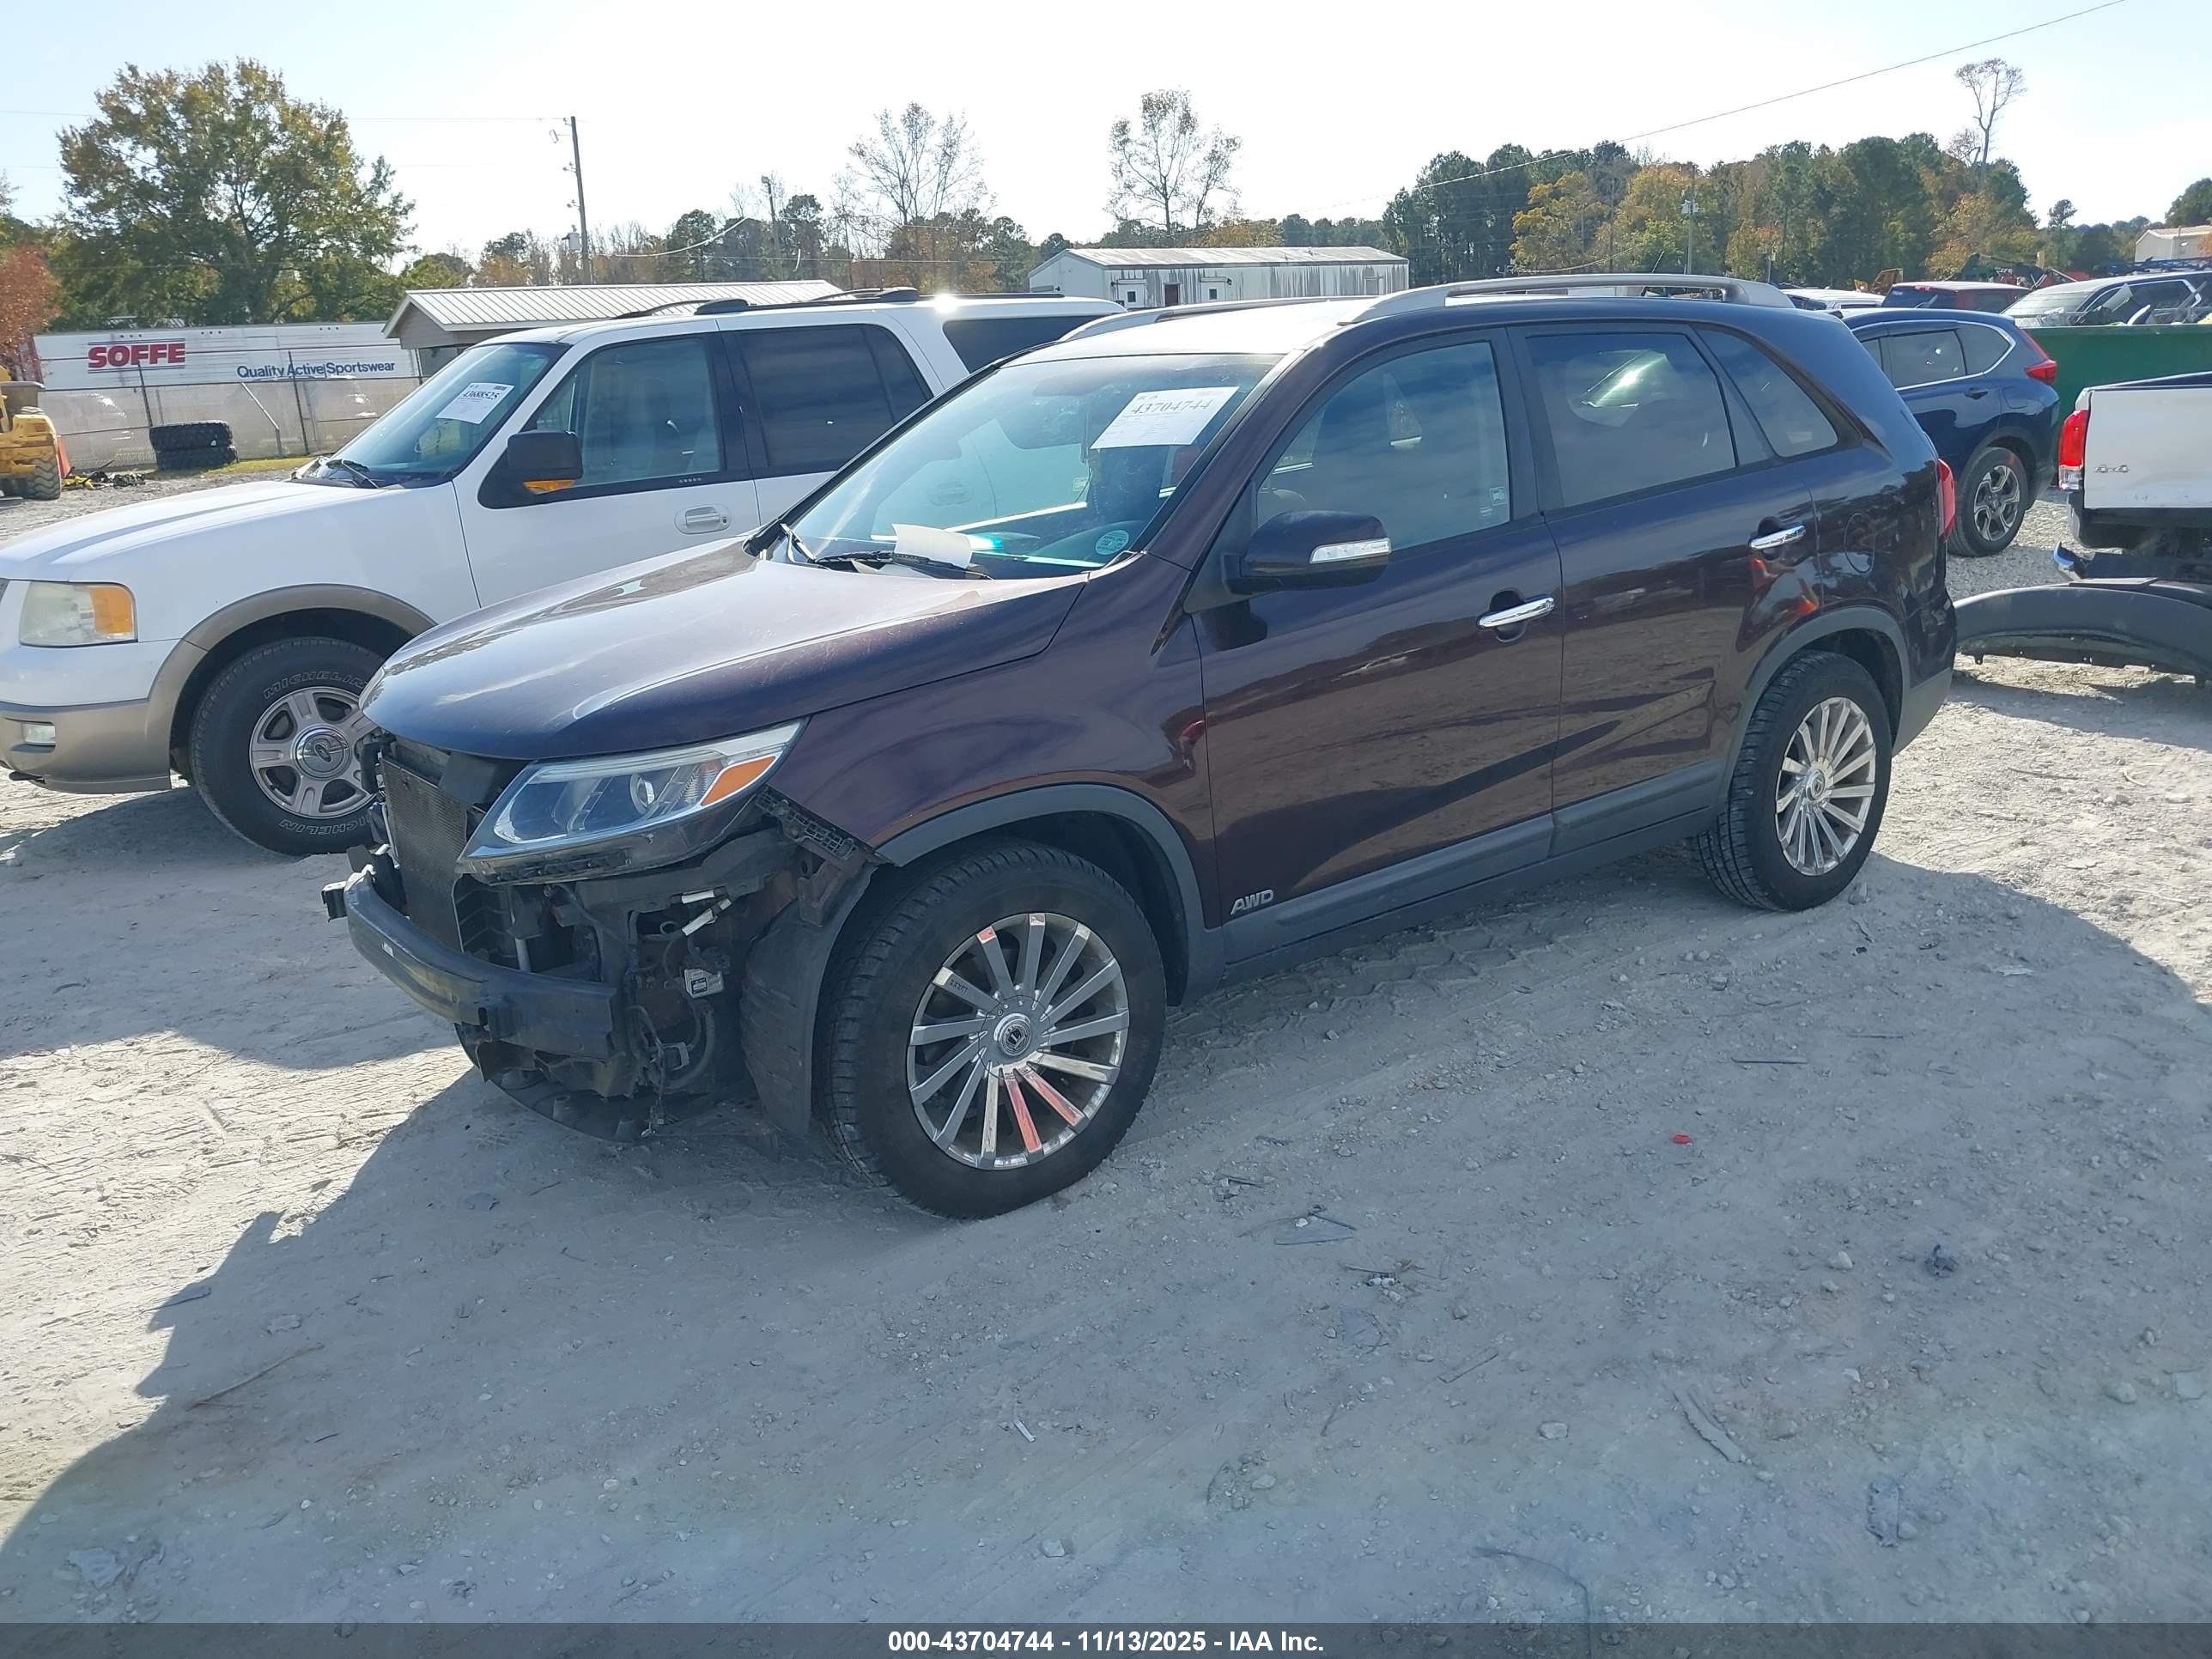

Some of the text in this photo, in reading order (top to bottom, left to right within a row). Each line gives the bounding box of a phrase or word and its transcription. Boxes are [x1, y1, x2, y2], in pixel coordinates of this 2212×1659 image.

[88, 343, 185, 368] SOFFE
[237, 362, 396, 378] Quality Active Sportswear
[1131, 398, 1215, 414] 43704744
[1230, 889, 1274, 915] AWD
